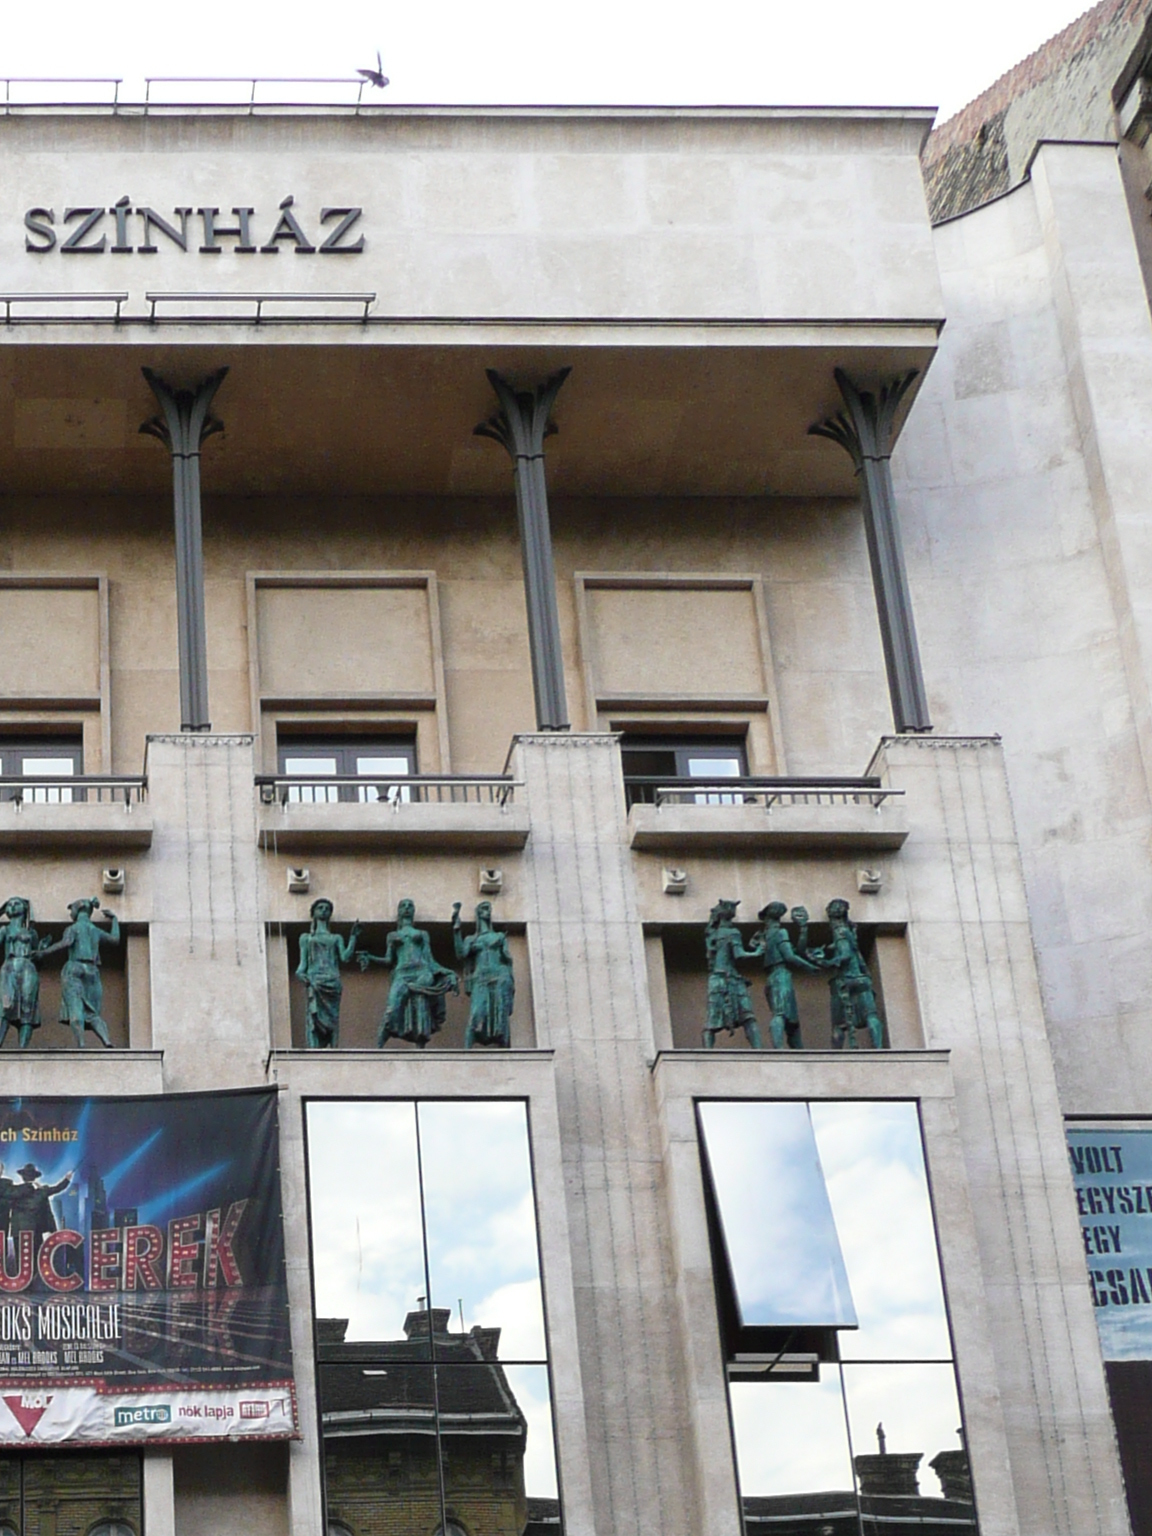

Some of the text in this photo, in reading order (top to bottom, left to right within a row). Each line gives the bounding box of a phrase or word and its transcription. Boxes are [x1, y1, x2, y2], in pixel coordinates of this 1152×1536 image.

[24, 195, 366, 254] SZÍNHÁZ
[22, 1127, 79, 1143] Színház
[1068, 1146, 1124, 1175] VOLT
[1083, 1225, 1122, 1255] EGY
[38, 1303, 123, 1341] MUSICALJE
[204, 1405, 234, 1420] lapja
